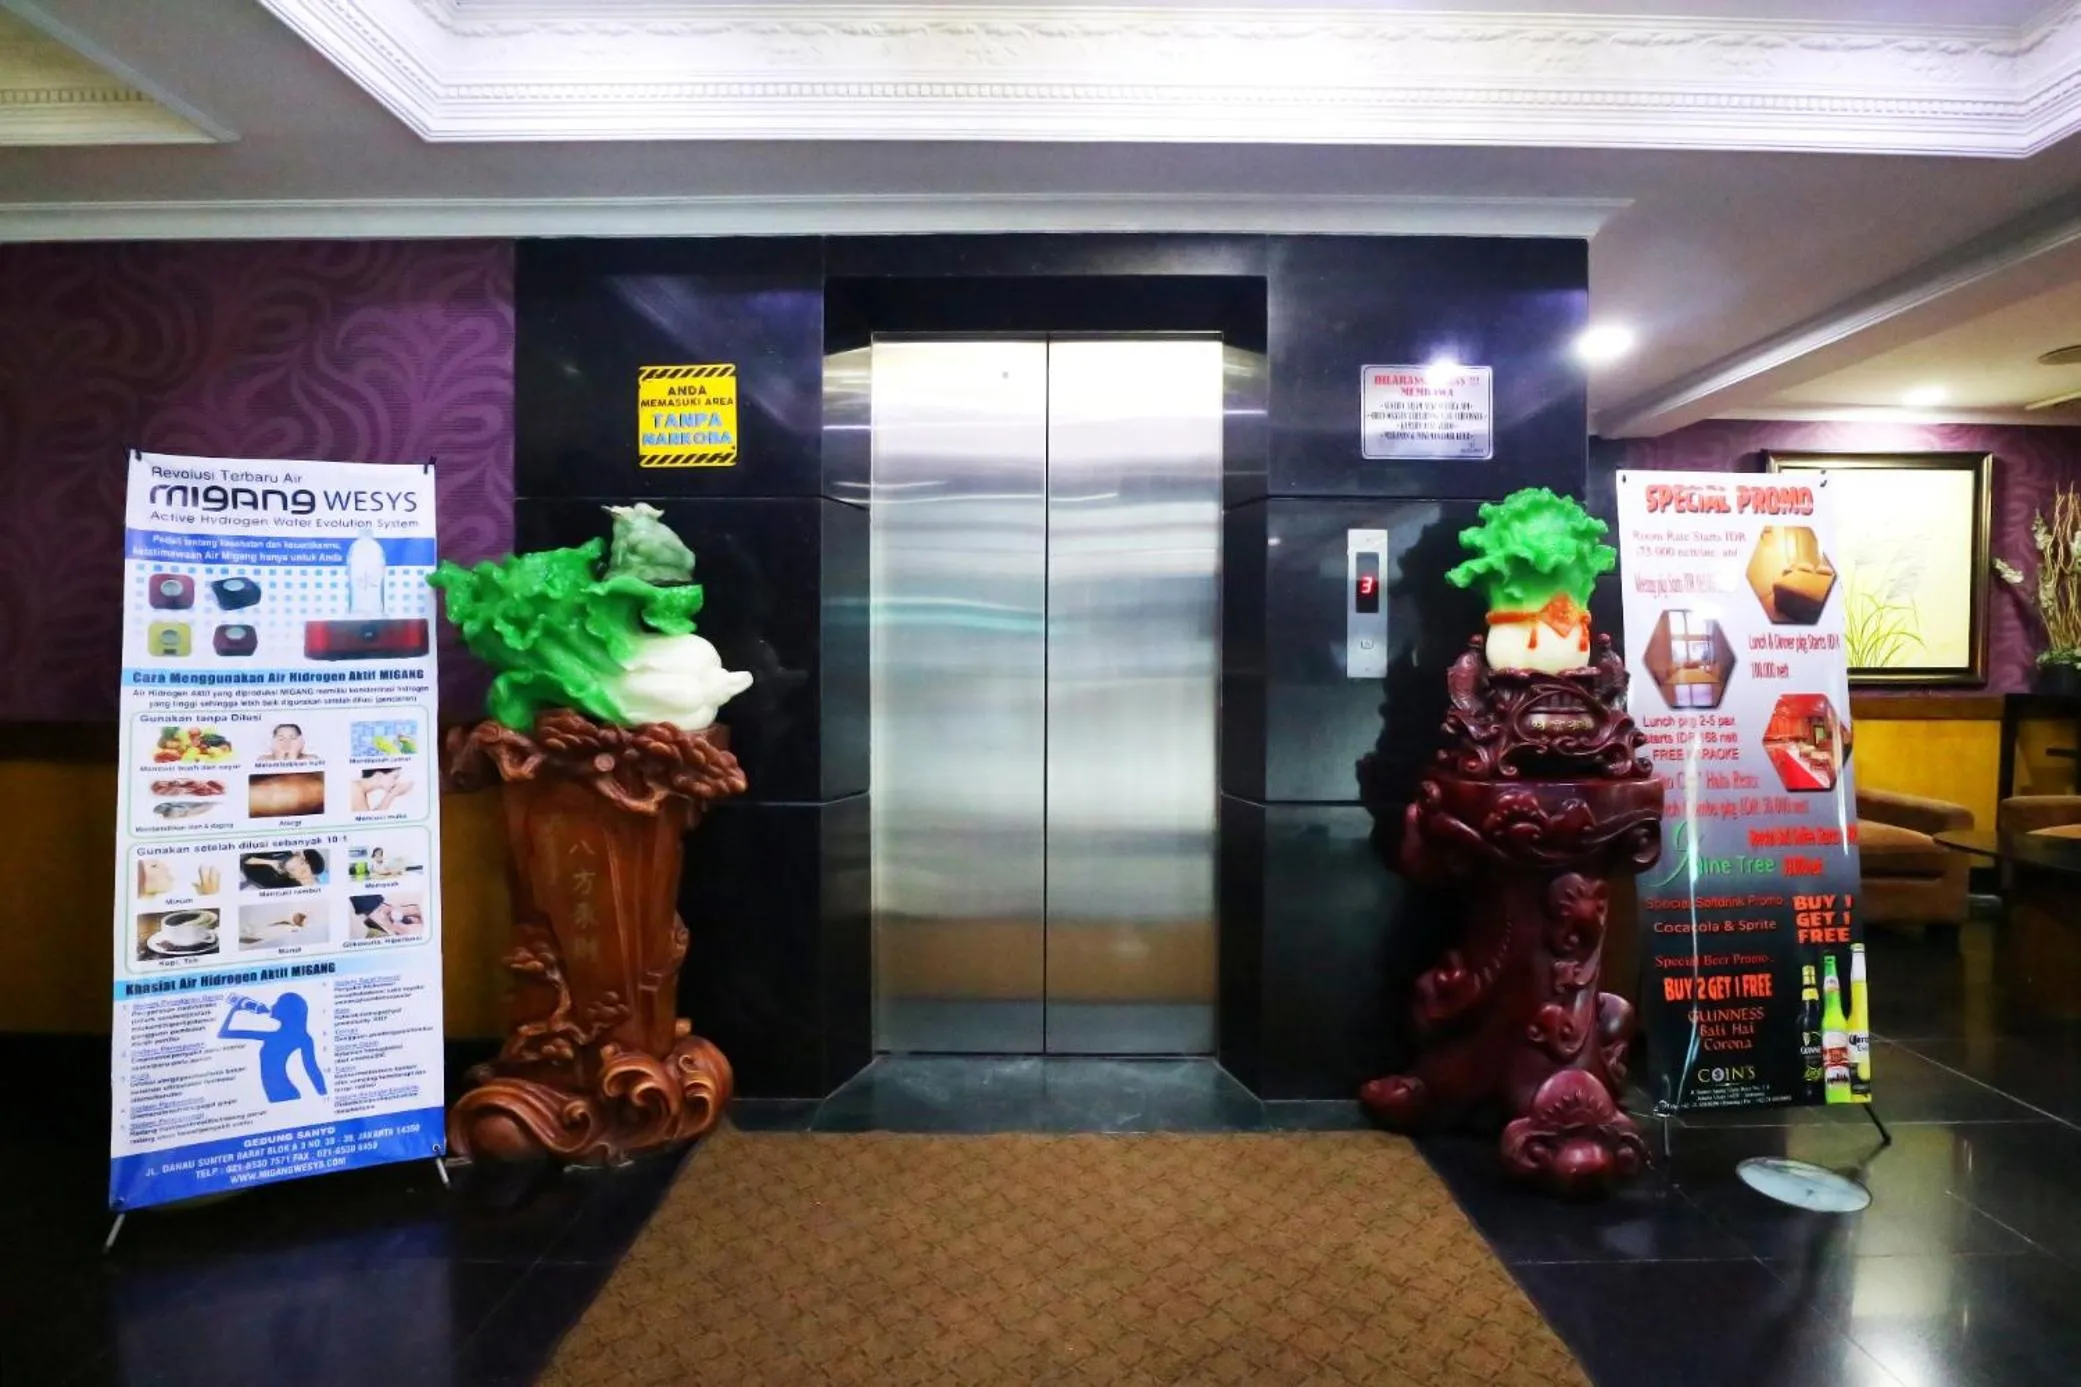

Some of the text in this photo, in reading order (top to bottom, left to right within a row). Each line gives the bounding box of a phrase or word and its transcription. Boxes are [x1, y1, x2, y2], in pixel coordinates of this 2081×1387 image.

[668, 386, 707, 395] ANDA
[641, 397, 733, 407] MEMASUKI AREA
[652, 413, 723, 428] TANPA
[642, 432, 733, 445] NARKOBA
[220, 470, 279, 483] Terbaru
[283, 473, 302, 483] Air
[323, 491, 418, 512] WESYS
[1646, 484, 1813, 516] SPECIAL PROMO
[150, 511, 420, 529] Active Hydrogen Water Evolution System
[204, 551, 219, 560] Air
[1361, 576, 1373, 593] 3
[133, 672, 166, 683] Cara
[169, 673, 264, 685] Menggunakan
[268, 673, 286, 684] Air
[289, 672, 346, 683] Hidrogen
[379, 669, 424, 680] MIGANG
[148, 689, 188, 698] Hidrogen
[140, 713, 262, 723] Gunakan tanpa Dilusi
[1643, 715, 1675, 727] Lunch
[1700, 715, 1715, 726] 2-5
[1654, 748, 1684, 760] FREE
[137, 846, 190, 856] Gunakan
[194, 843, 235, 853] setelah
[238, 841, 269, 850] dilusi
[272, 837, 323, 848] sebanyak
[1735, 855, 1775, 874] Tree
[1696, 896, 1744, 909] Softdrink
[1747, 894, 1784, 907] Promo
[1792, 894, 1836, 910] BUY
[1653, 920, 1776, 933] Cocacola & Sprite
[1796, 911, 1836, 927] GET
[1798, 928, 1850, 944] FREE
[1655, 955, 1699, 969] Special
[1703, 954, 1729, 966] Beer
[126, 980, 175, 996] Khasiat
[179, 978, 197, 990] Air
[200, 972, 257, 987] Hidrogen
[291, 962, 336, 976] MIGANG
[1664, 977, 1693, 1001] BUY
[1697, 977, 1706, 999] 2
[1708, 975, 1732, 1000] GET
[1742, 973, 1773, 997] FREE
[1688, 1006, 1765, 1023] GUINNESS
[1700, 1022, 1754, 1037] Bali Hai
[1704, 1038, 1752, 1051] Corona
[244, 1126, 336, 1147] GEDUNG SANYO
[198, 1154, 234, 1166] SUNTER
